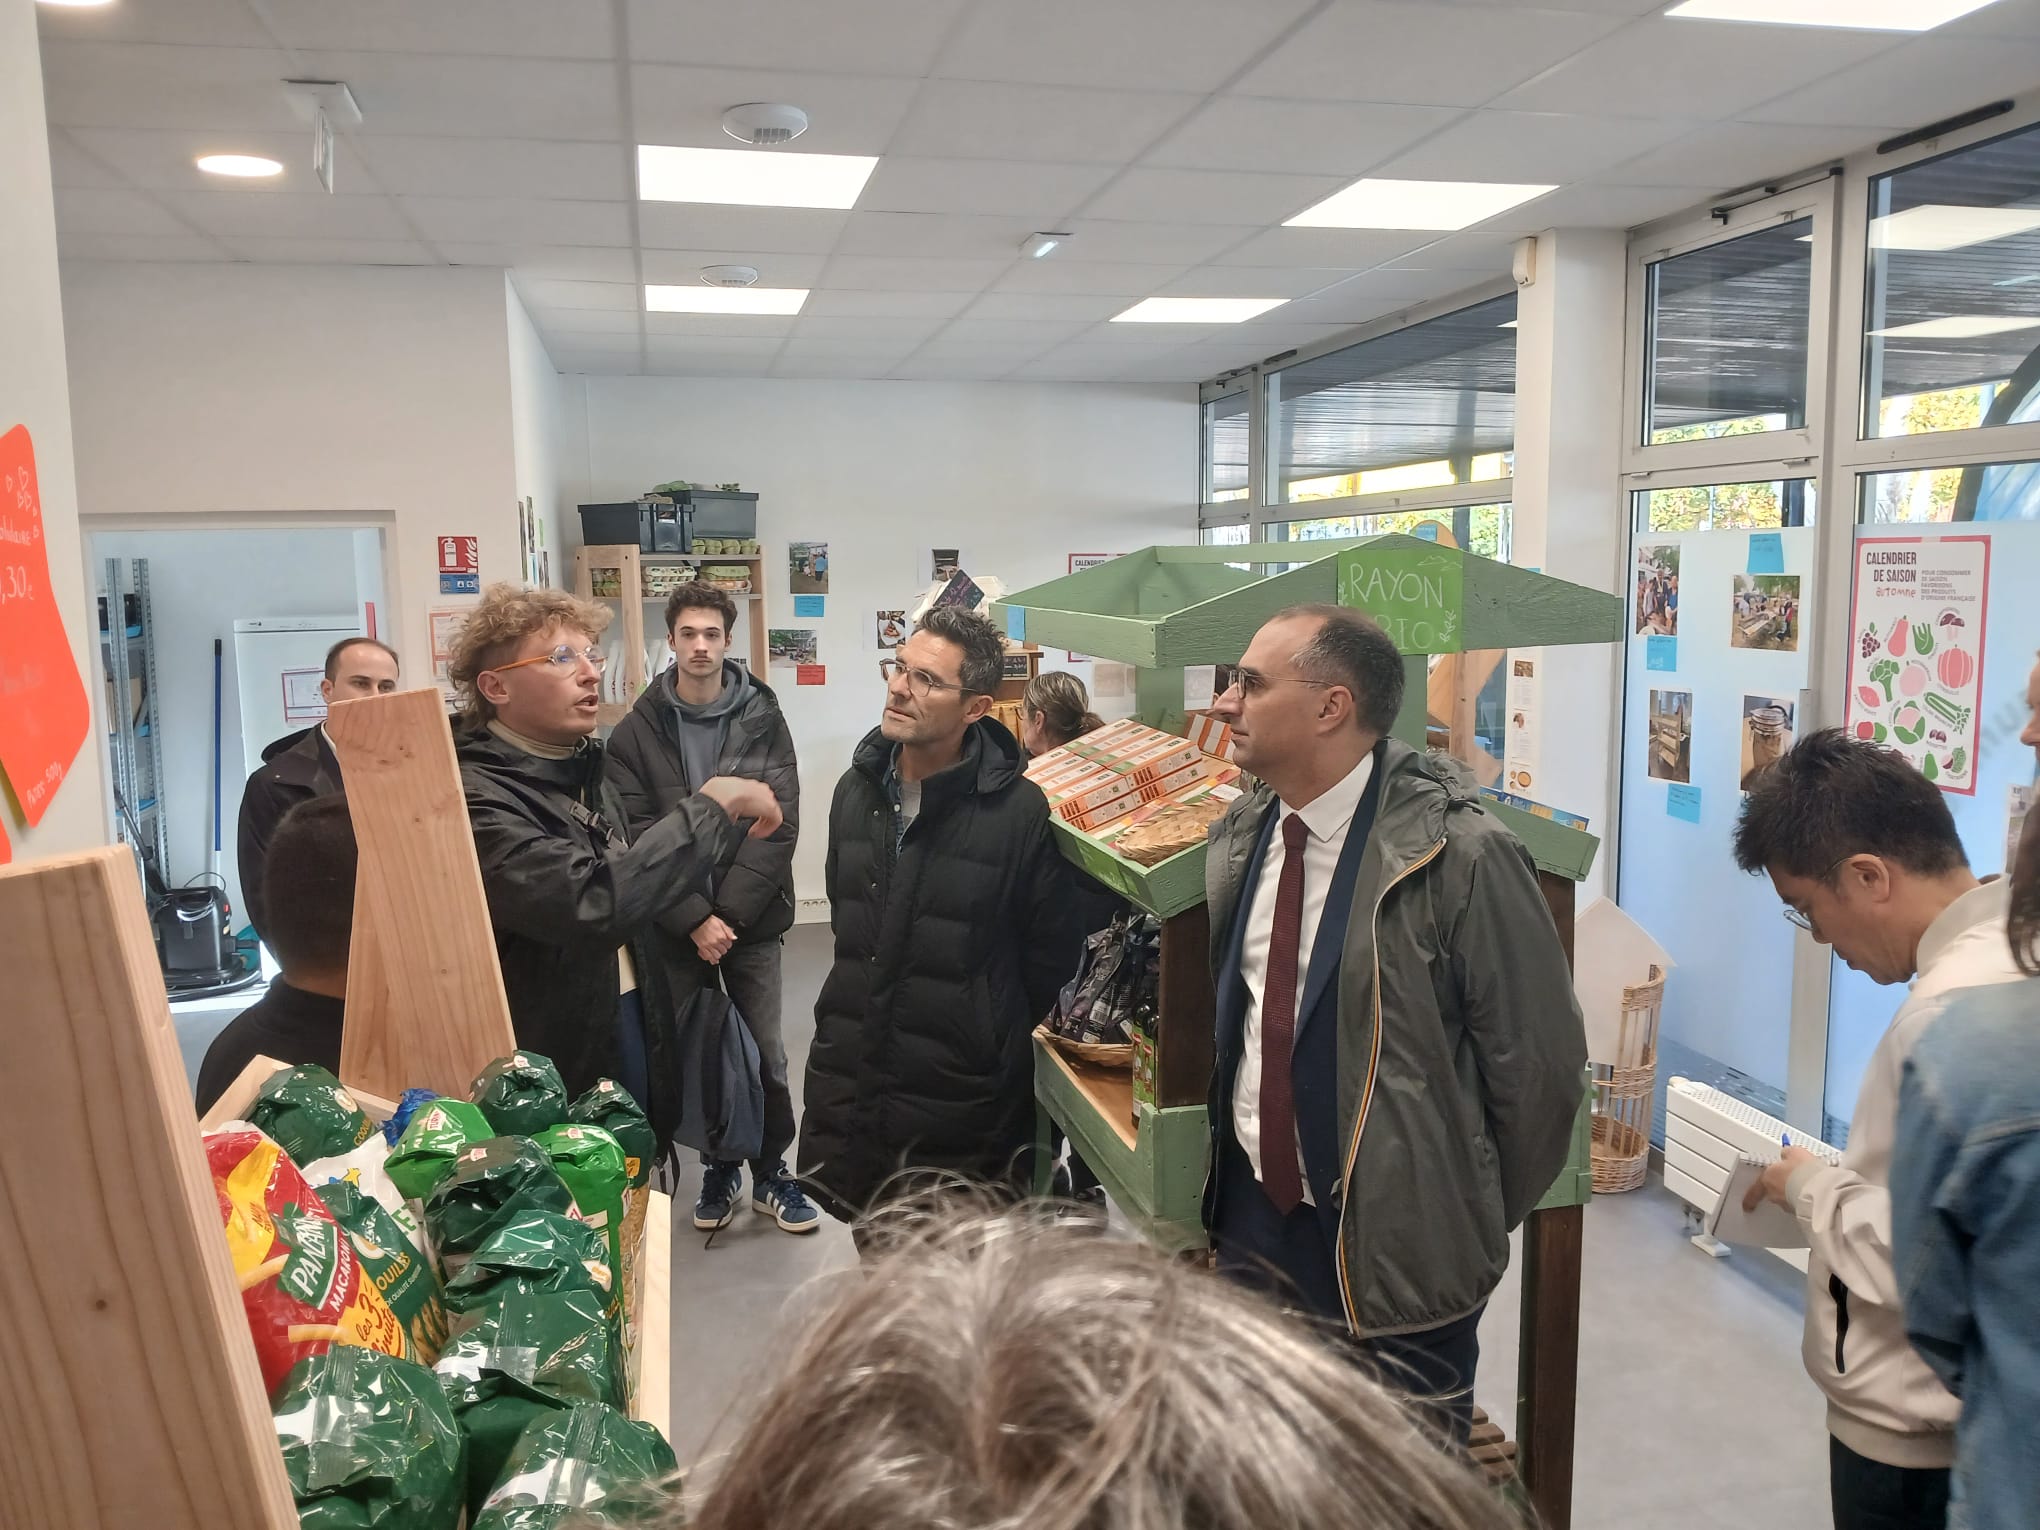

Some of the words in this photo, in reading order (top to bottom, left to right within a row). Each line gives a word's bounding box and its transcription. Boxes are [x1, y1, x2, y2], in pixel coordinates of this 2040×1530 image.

[1866, 552, 1917, 565] CALENDRIER
[1350, 563, 1443, 608] RAYON
[1873, 570, 1885, 582] DE
[1886, 570, 1917, 582] SAISON
[329, 1238, 352, 1313] MACARONI
[358, 1292, 383, 1330] 3
[355, 1317, 373, 1342] les
